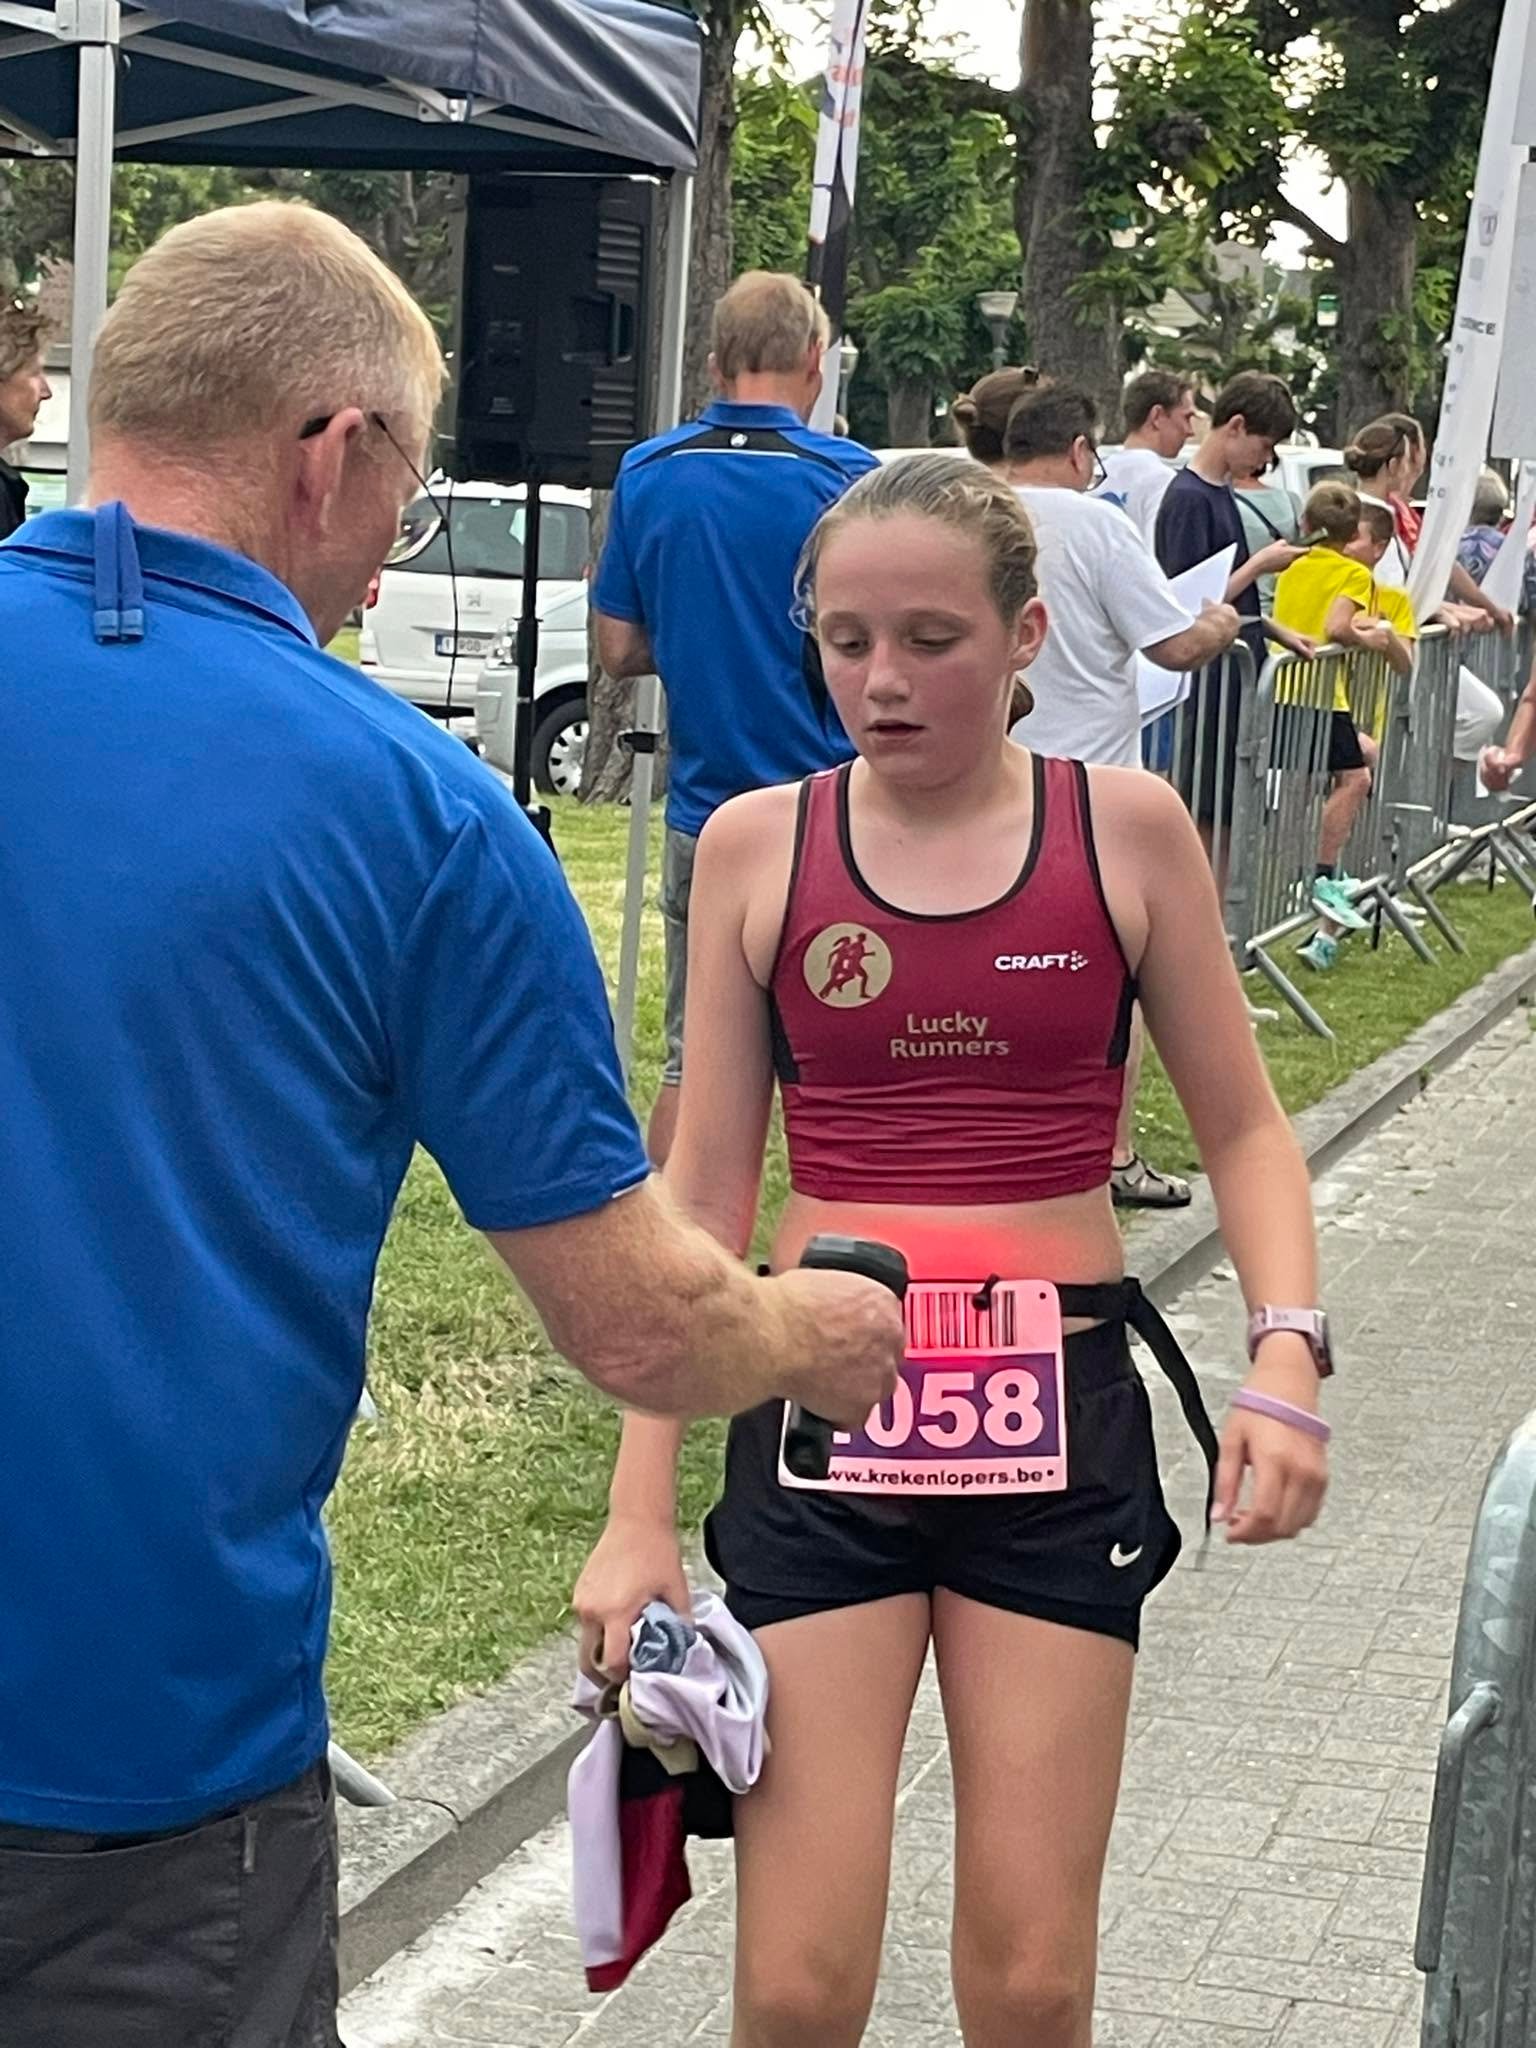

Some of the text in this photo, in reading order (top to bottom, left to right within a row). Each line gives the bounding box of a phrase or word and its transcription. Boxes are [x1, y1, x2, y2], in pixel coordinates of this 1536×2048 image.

[994, 953, 1070, 971] CRAFT
[906, 1010, 989, 1038] Lucky
[890, 1037, 1009, 1059] Runners
[833, 1367, 1044, 1449] 058
[828, 1466, 1043, 1490] ww.krekenlopers.be
